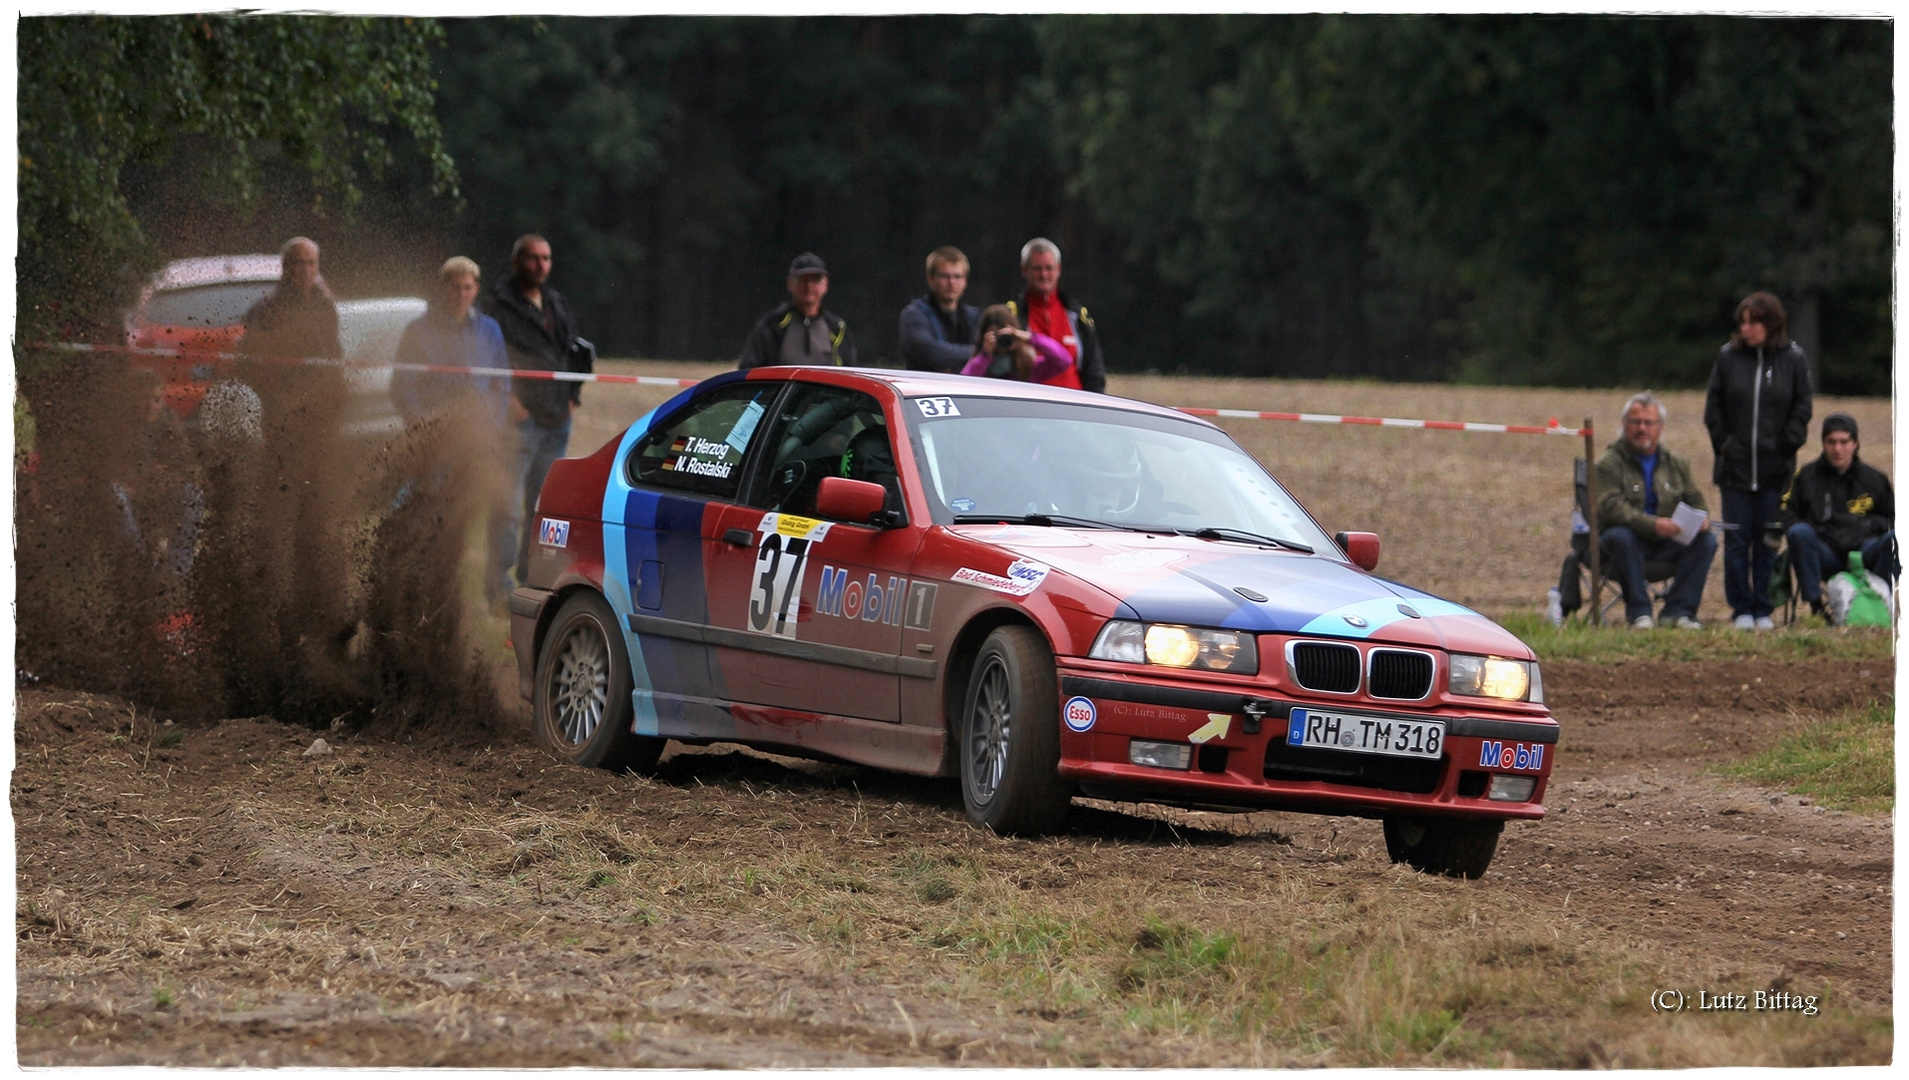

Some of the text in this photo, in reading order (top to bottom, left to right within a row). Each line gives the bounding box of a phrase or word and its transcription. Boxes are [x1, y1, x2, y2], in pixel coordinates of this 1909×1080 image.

[919, 399, 952, 416] 37
[685, 436, 730, 460] T. Herzog
[674, 455, 733, 479] N. Rostalski
[542, 520, 569, 546] Mobil
[751, 533, 809, 632] 37
[956, 569, 974, 580] Bad
[972, 572, 1026, 593] Schmiedeberg
[1011, 566, 1045, 580] MSC
[816, 564, 908, 627] Mobil
[1069, 705, 1091, 722] Esso
[1305, 715, 1441, 754] RH TM 318
[1480, 741, 1544, 771] Mobil
